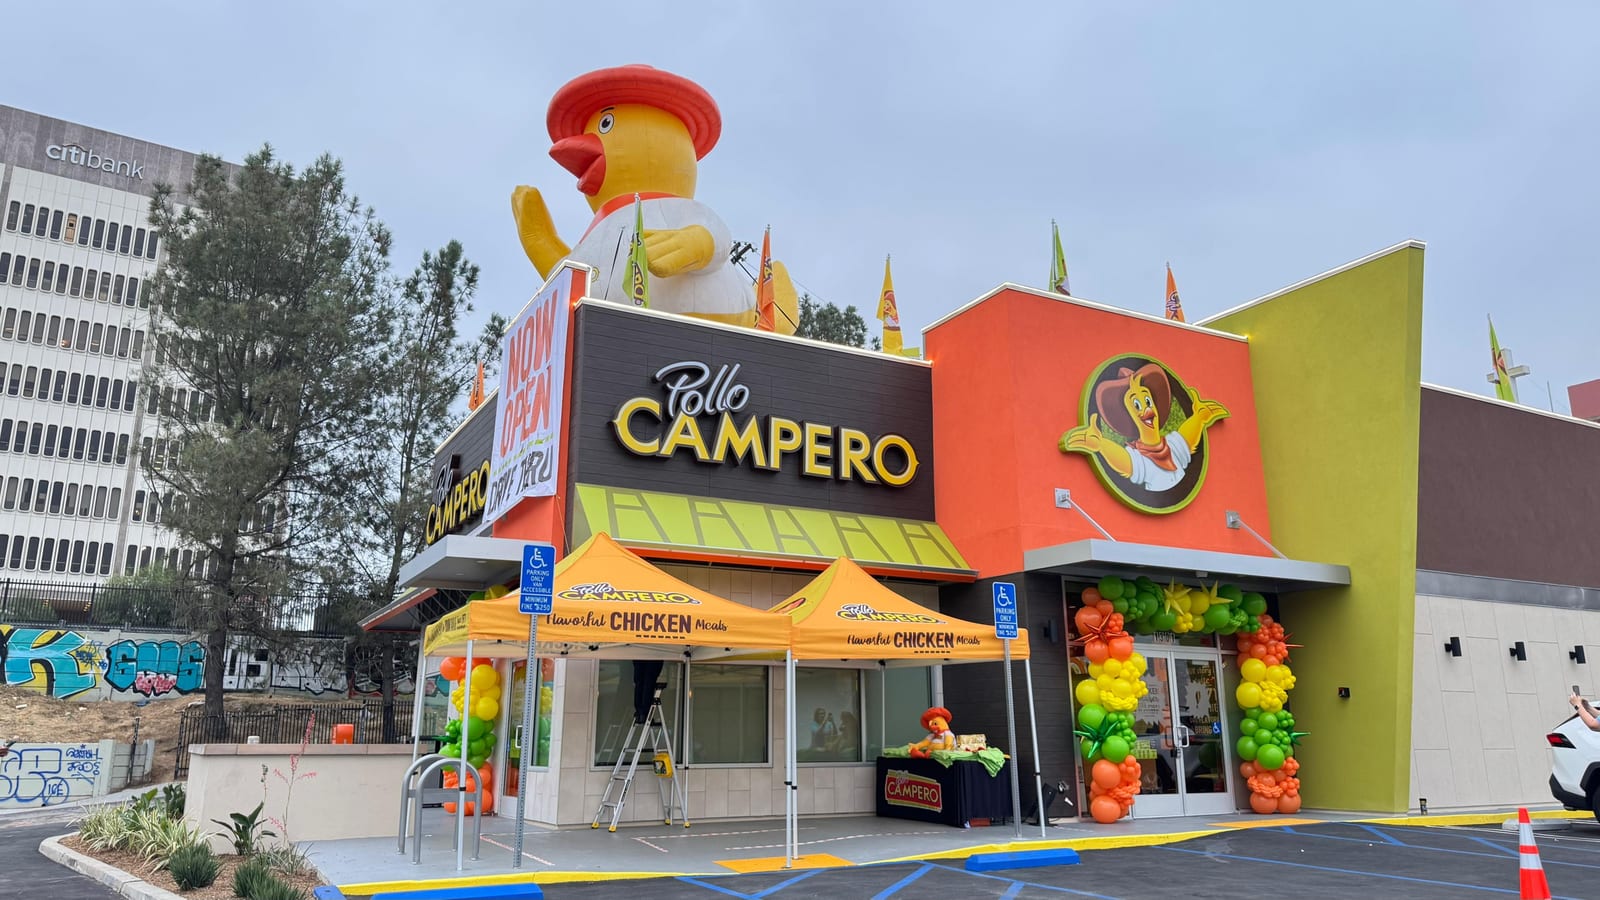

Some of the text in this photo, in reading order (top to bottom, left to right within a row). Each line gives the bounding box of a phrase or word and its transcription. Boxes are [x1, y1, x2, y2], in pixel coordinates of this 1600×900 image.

[46, 143, 144, 180] citibank
[506, 289, 558, 399] NOW
[655, 360, 750, 419] Pollo
[501, 365, 553, 458] OPEN
[608, 396, 920, 488] CAMPERO
[426, 459, 491, 545] CAMPERO
[526, 569, 550, 577] PARKING
[530, 575, 545, 583] ONLY
[522, 586, 552, 594] ACCESSIBLE
[571, 582, 614, 595] Pollo
[521, 602, 533, 610] FINE
[559, 591, 692, 604] CAMPERO
[838, 611, 939, 624] CAMPERO
[842, 604, 874, 614] Pollo
[546, 611, 728, 634] Flavorful CHICKEN Meals
[847, 631, 981, 648] Flavorful CHICKEN Meals
[887, 781, 939, 803] CAMPERO
